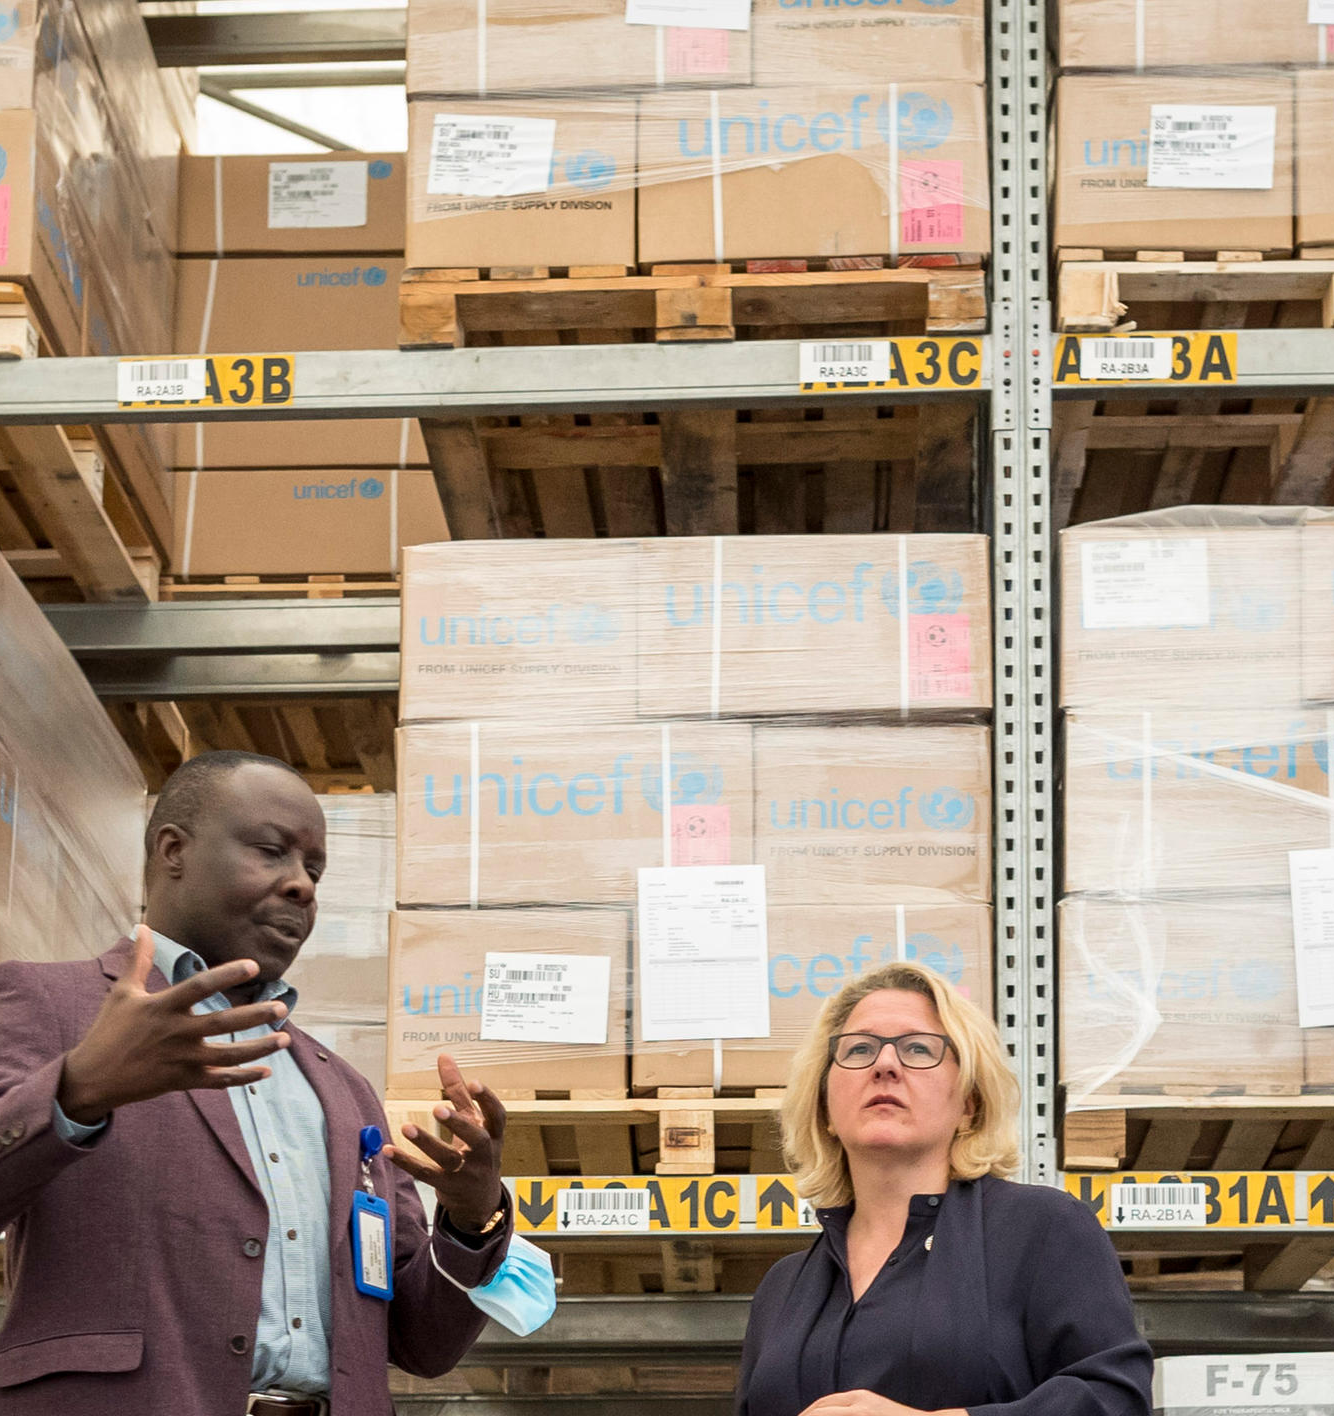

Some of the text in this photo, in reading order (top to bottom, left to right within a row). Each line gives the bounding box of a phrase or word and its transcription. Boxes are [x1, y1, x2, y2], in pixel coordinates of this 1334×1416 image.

[677, 94, 871, 157] unicef
[1080, 178, 1117, 189] FROM
[427, 199, 612, 213] FROM UNICEF SUPPLY DIVISION
[297, 266, 361, 288] unicef
[819, 366, 868, 378] RA-2A3C
[1100, 362, 1150, 375] RA-2B3A
[136, 384, 184, 397] RA-2A3B
[293, 477, 357, 500] unicef
[666, 562, 874, 627] unicef
[419, 604, 557, 647] unicef
[418, 663, 455, 675] FROM
[459, 663, 506, 675] UNICEF
[424, 754, 634, 819] unicef
[769, 786, 914, 831] unicef
[863, 845, 914, 858] SUPPLY
[917, 845, 976, 858] DIVISION
[402, 1031, 439, 1042] FROM
[575, 1213, 638, 1226] RA-2A1C
[1131, 1207, 1194, 1222] RA-2B1A
[1205, 1362, 1299, 1398] F-75
